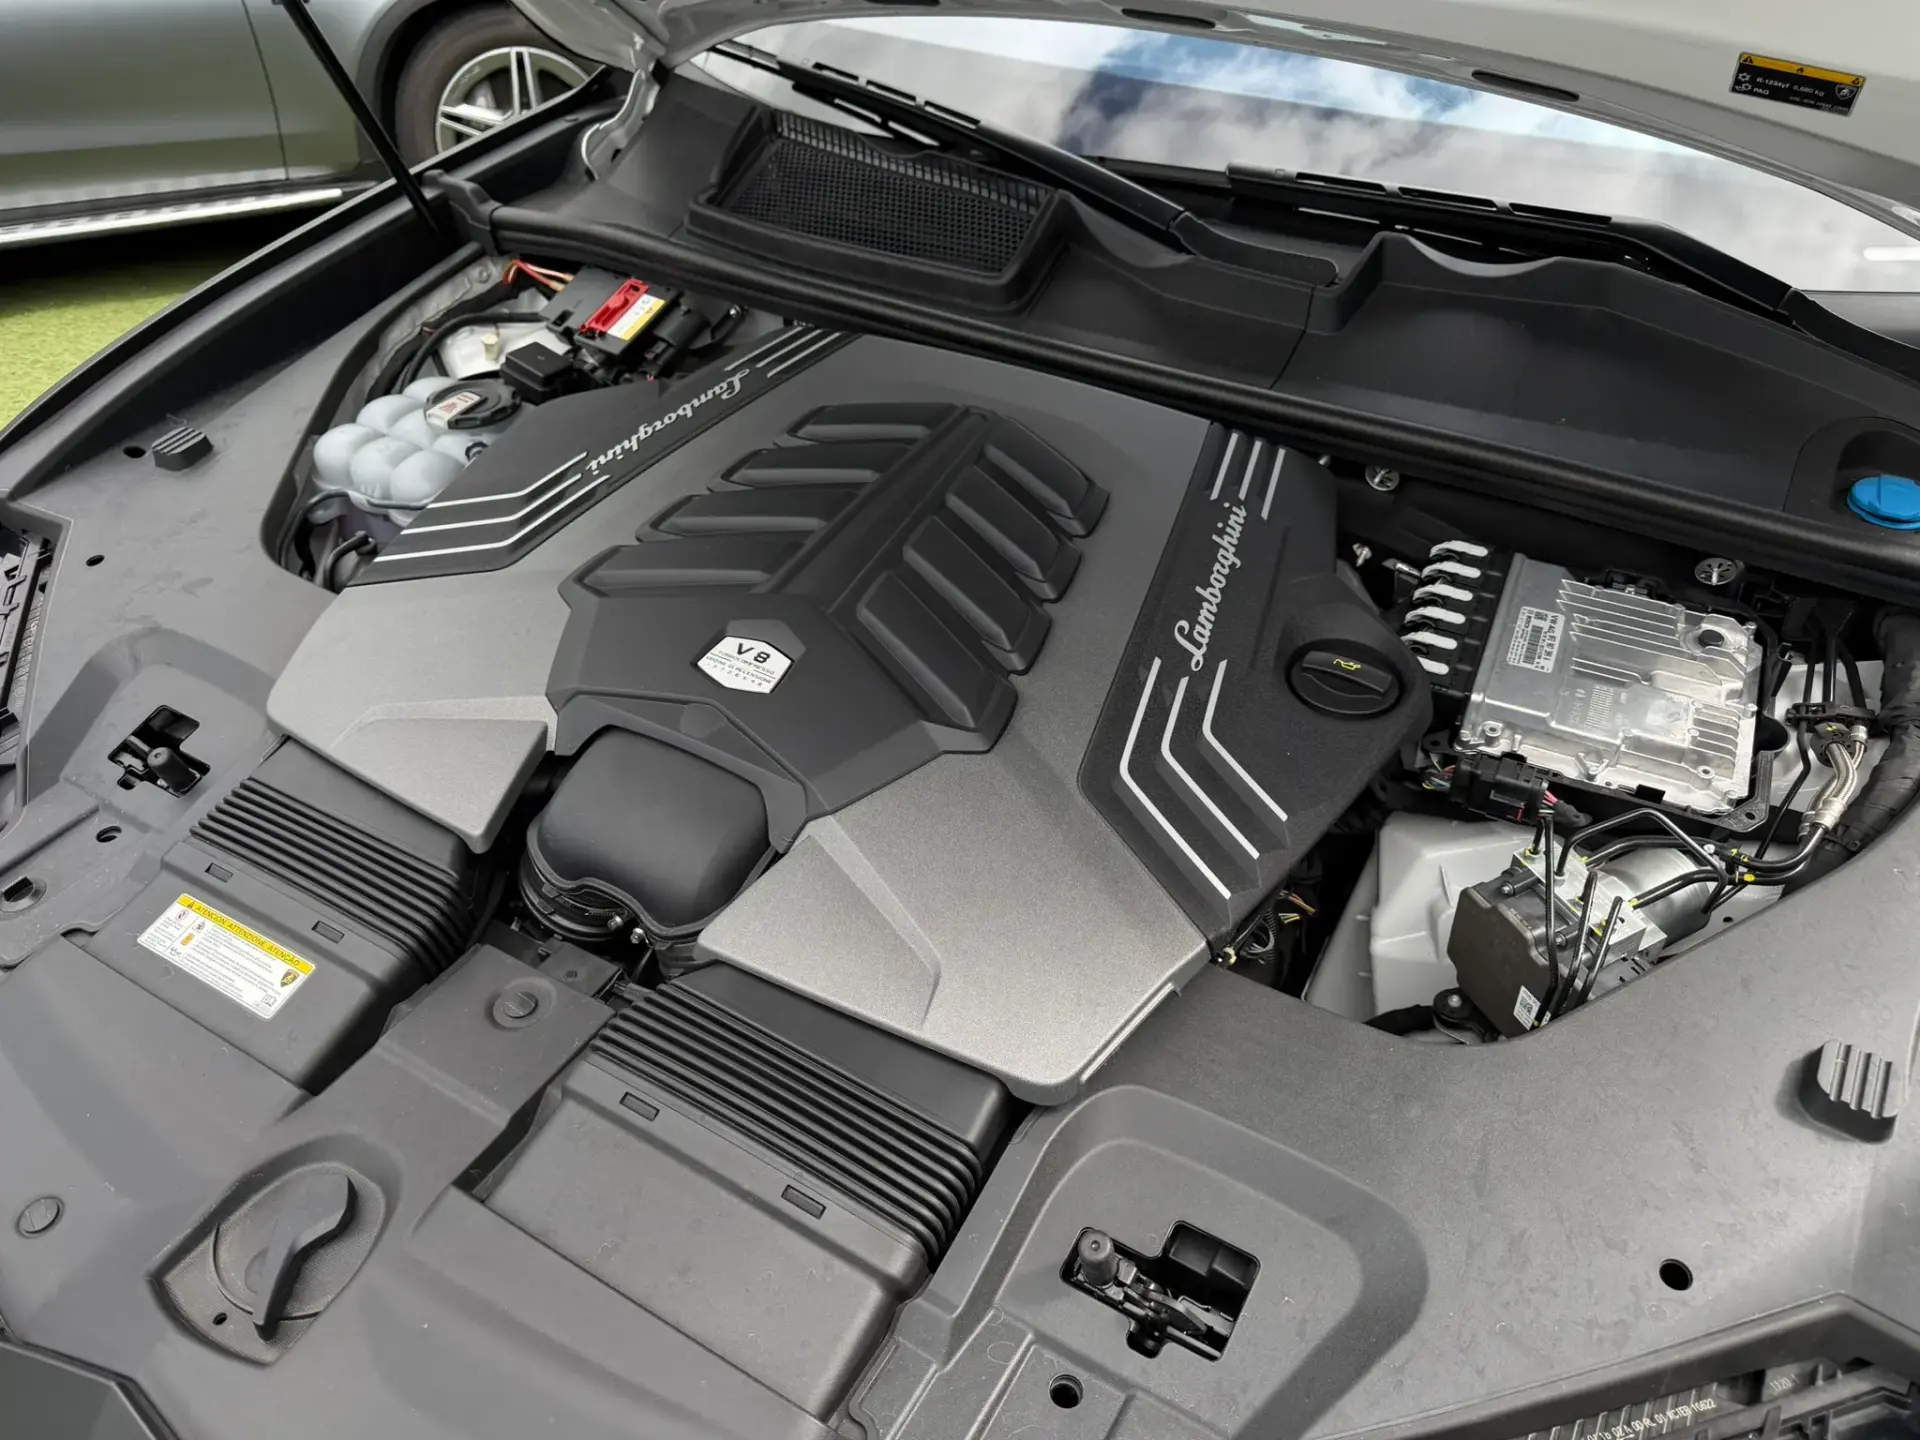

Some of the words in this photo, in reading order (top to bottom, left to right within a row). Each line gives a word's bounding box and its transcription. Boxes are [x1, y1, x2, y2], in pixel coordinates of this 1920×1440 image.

[585, 368, 750, 476] Lamborghini
[1174, 501, 1248, 672] Lamborghini
[227, 921, 270, 951] ATTENZIONE
